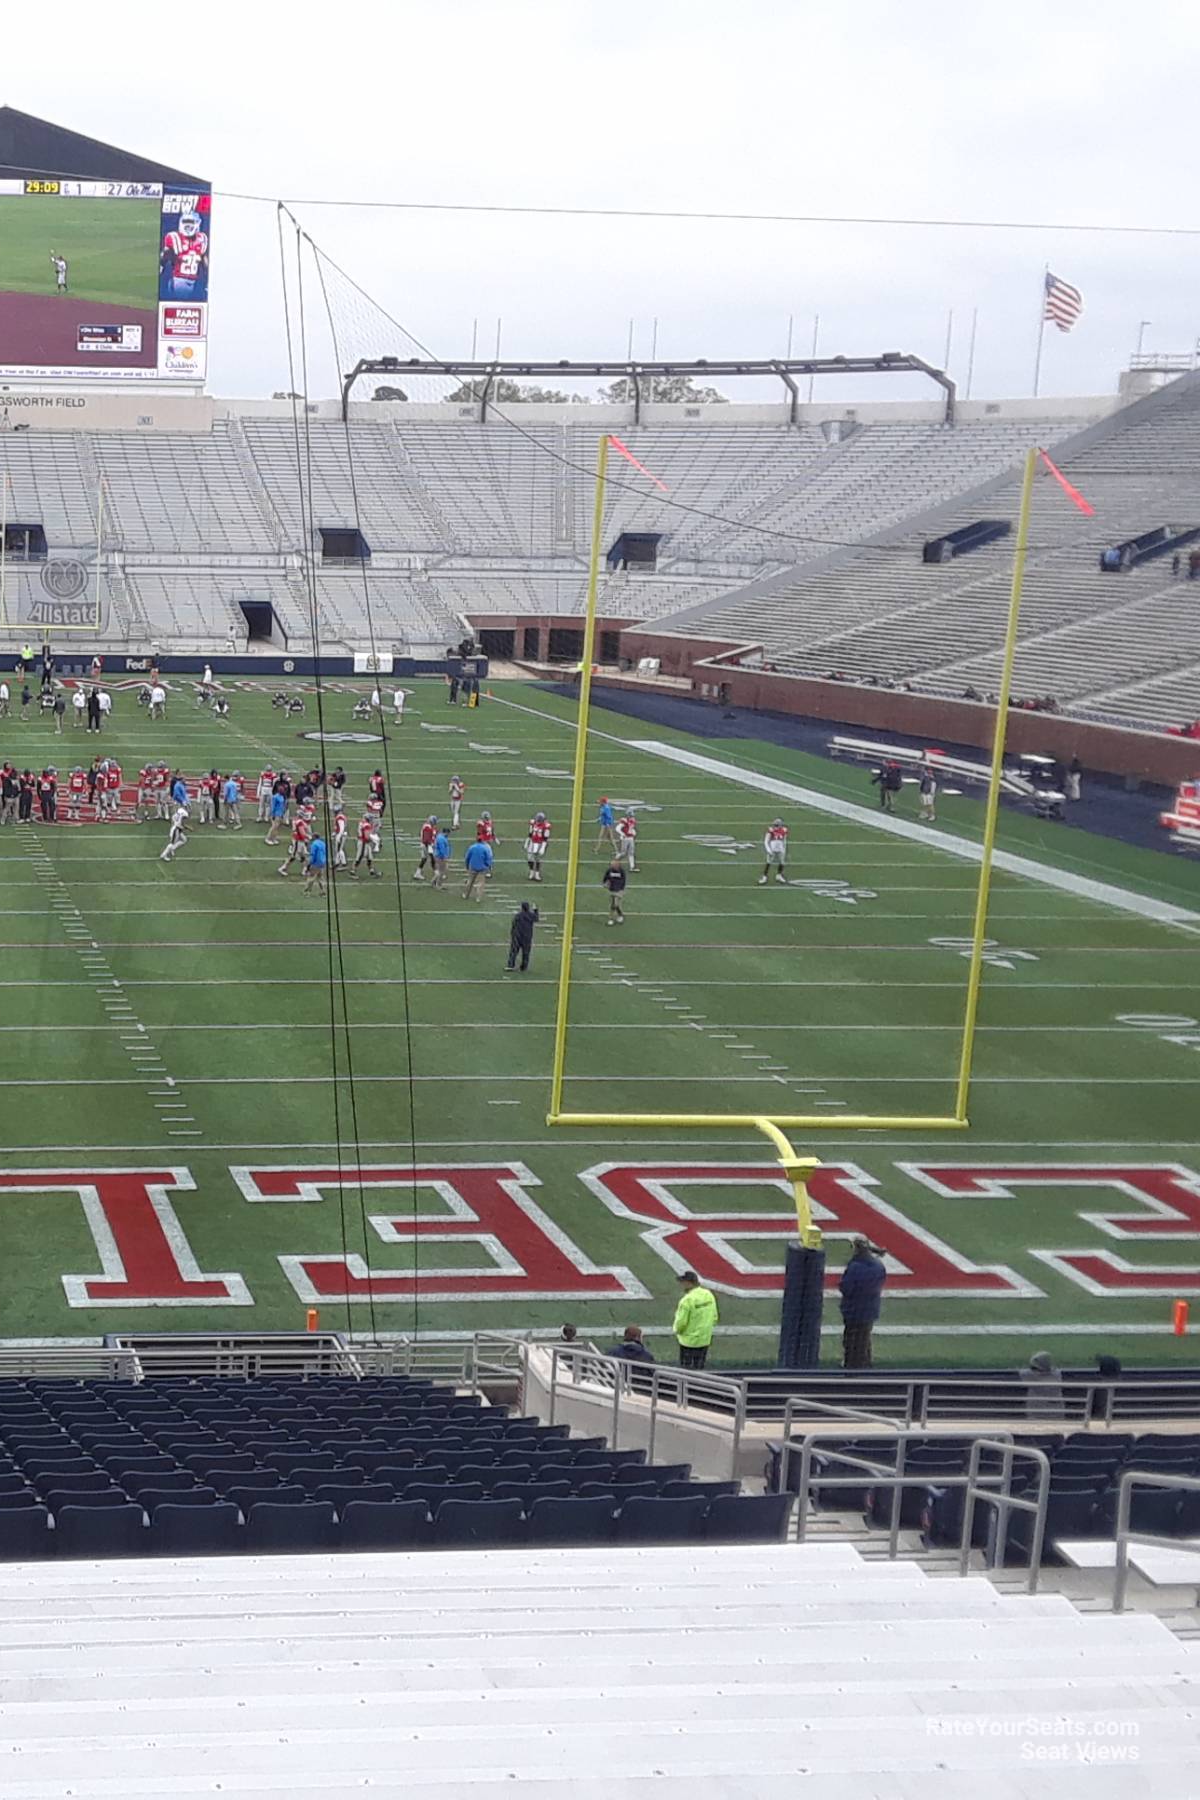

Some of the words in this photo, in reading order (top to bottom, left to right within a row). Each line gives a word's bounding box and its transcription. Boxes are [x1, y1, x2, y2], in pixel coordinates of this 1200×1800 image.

[26, 181, 59, 193] 29:09
[108, 183, 123, 195] 27
[56, 397, 86, 407] FIELD
[28, 603, 98, 624] Allstate
[126, 658, 153, 669] FedE
